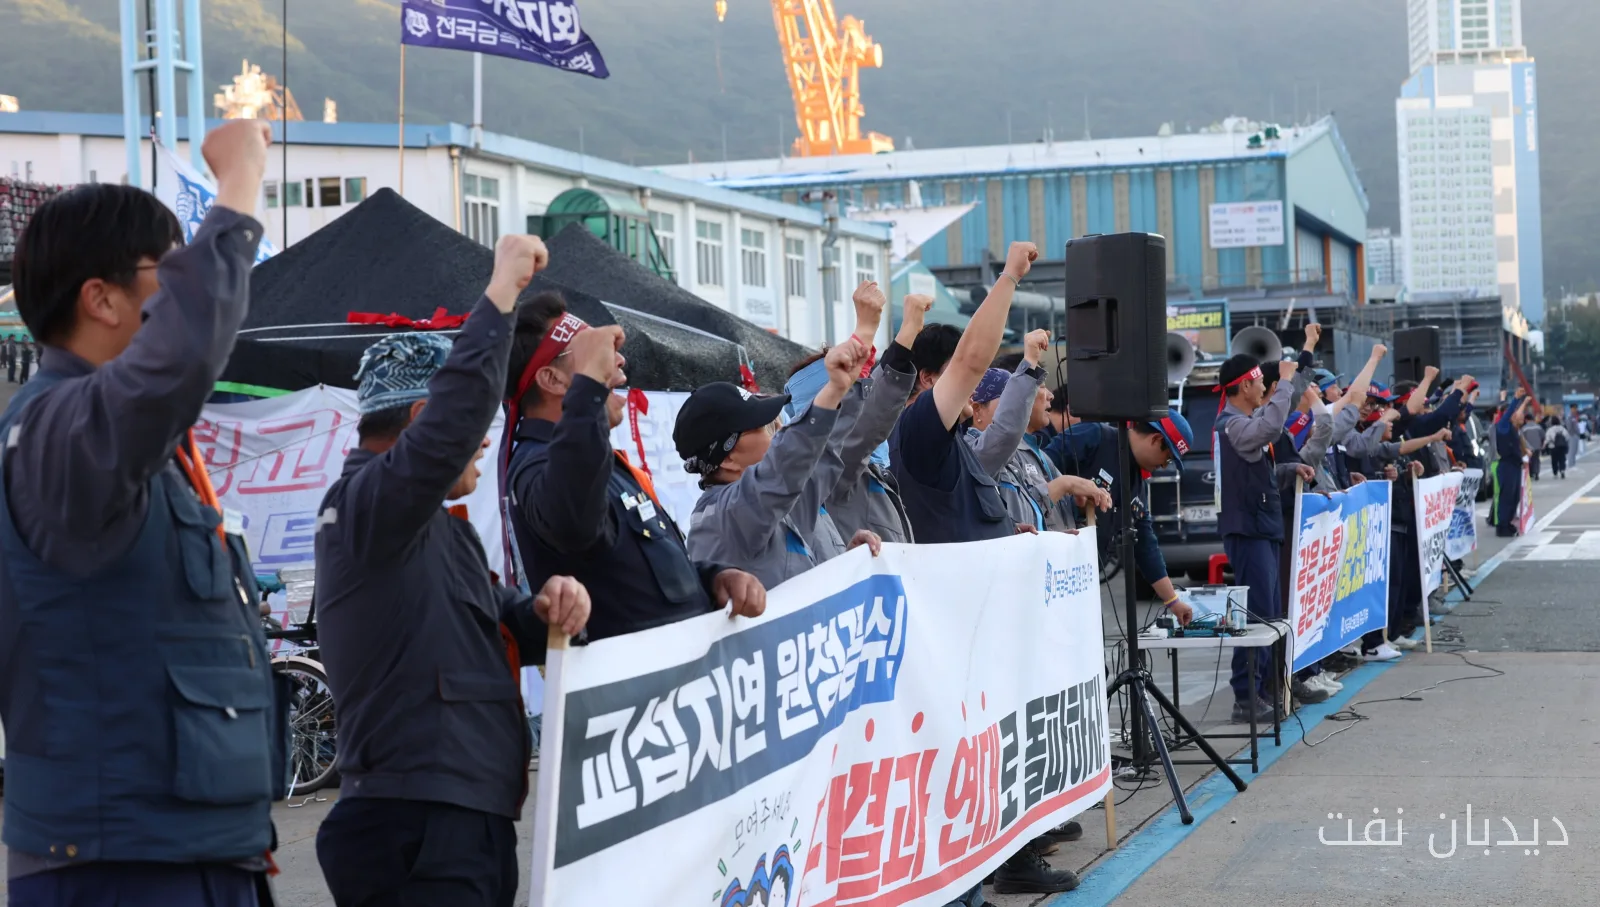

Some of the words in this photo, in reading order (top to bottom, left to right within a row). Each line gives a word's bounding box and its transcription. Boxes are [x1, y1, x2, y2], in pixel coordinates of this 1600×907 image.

[576, 649, 766, 829] 교섭지연
[776, 596, 906, 741] 원청꼼수!
[939, 710, 1019, 866] 연대로
[1025, 673, 1107, 811] 돌파하자!
